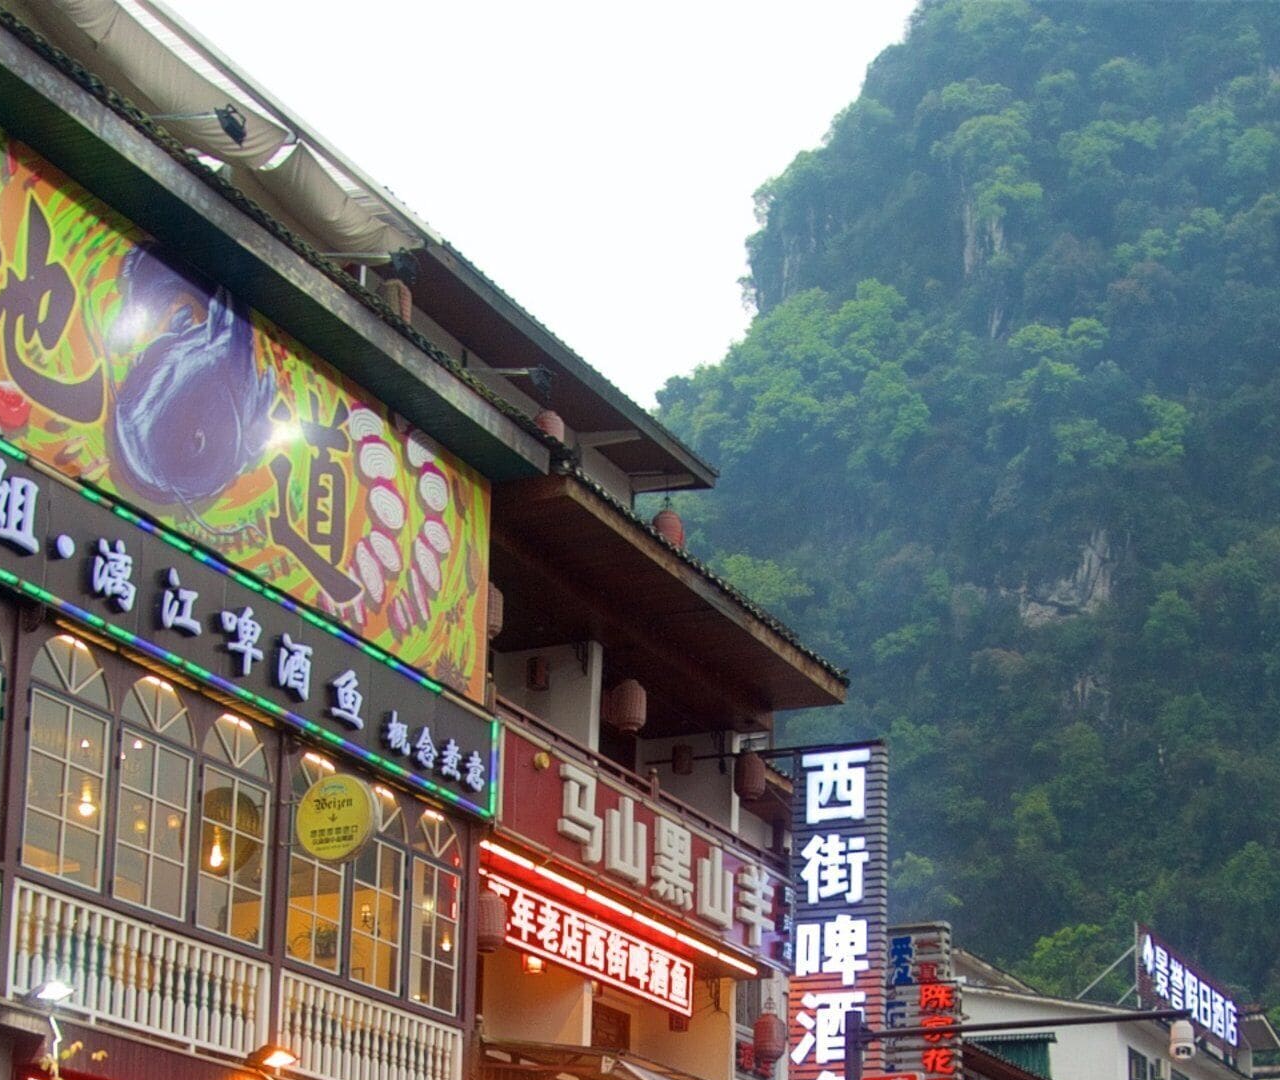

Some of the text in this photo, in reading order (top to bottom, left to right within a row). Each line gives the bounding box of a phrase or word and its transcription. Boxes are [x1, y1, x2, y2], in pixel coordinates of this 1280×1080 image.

[313, 797, 354, 812] Weizen
[557, 762, 775, 948] 马山黑山羊
[488, 880, 689, 1008] 年老店西街啤酒鱼
